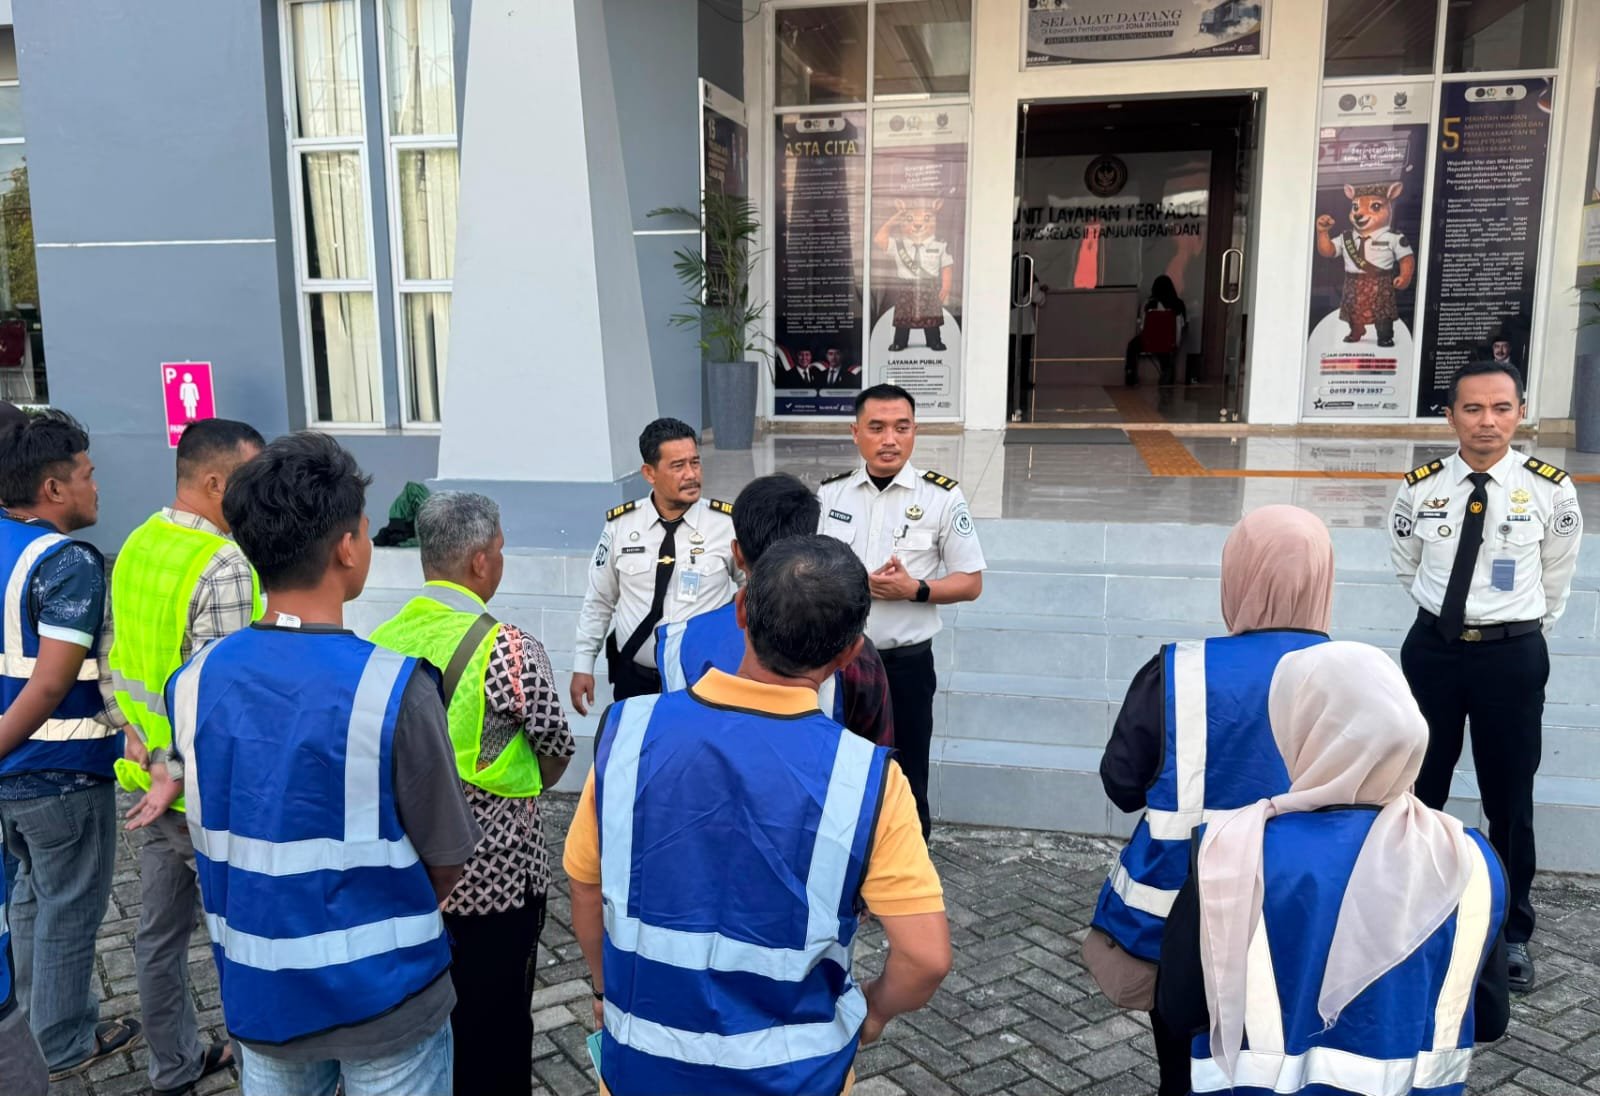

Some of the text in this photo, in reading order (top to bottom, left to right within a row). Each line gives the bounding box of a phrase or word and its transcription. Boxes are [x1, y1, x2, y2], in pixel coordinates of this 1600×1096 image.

[1040, 9, 1183, 28] SELAMAT DATANG
[1442, 116, 1461, 152] 5
[785, 140, 857, 157] ASTA CITA
[1049, 205, 1120, 224] LAYANAN
[1092, 223, 1200, 240] TANJUNGPANDAN
[165, 367, 177, 384] P
